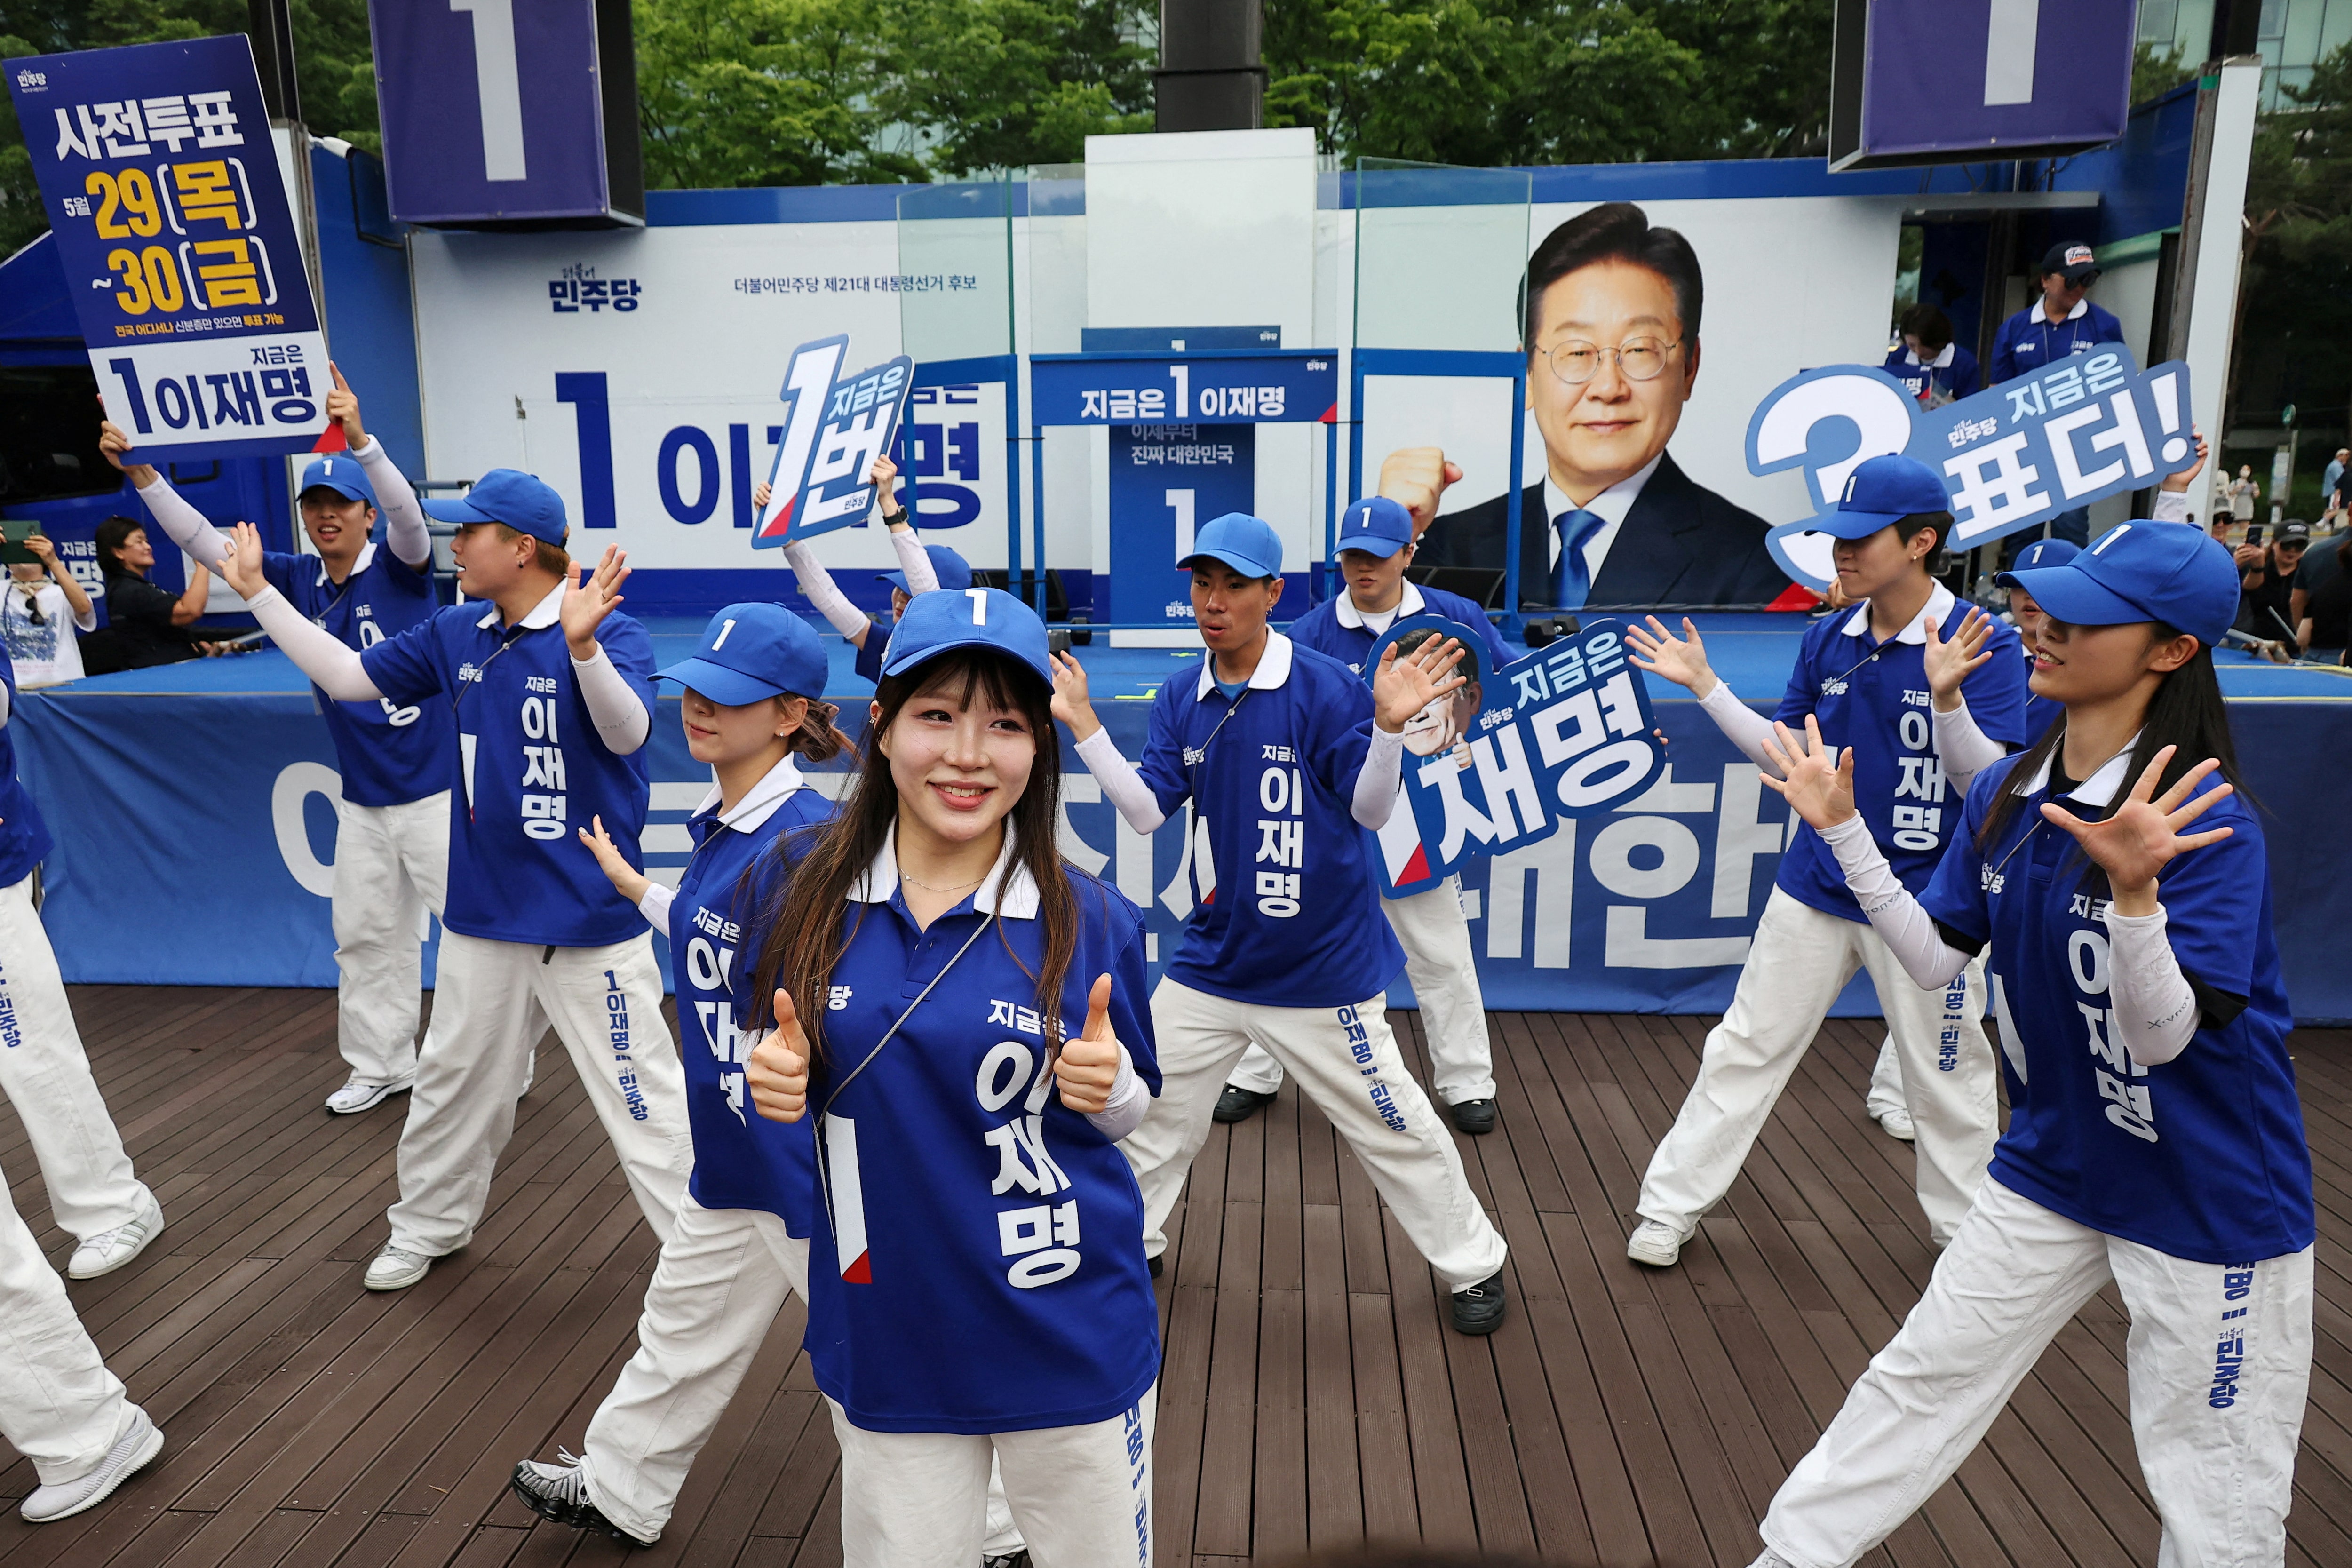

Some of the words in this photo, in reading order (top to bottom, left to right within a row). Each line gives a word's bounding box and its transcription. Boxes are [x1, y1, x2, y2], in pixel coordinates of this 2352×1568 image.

[449, 0, 527, 181] 1
[54, 90, 245, 162] 사전투표
[63, 195, 92, 218] 5월
[85, 156, 258, 240] 29(목)
[92, 235, 278, 316] ~30(금)
[548, 279, 642, 312] 민주당
[734, 275, 820, 294] 더불어민주당
[824, 275, 870, 293] 제21대
[874, 275, 944, 293] 대통령선거
[947, 274, 977, 292] 후보
[115, 324, 135, 338] 전국
[135, 321, 175, 336] 어디서나
[175, 318, 213, 333] 신분증만
[213, 316, 243, 330] 있으면
[243, 314, 264, 327] 투표
[250, 344, 304, 366] 지금은
[109, 358, 153, 434] 1
[155, 366, 317, 430] 이재명
[827, 364, 906, 422] 지금은
[1081, 388, 1166, 419] 지금은
[1169, 365, 1189, 418] 1
[1200, 386, 1286, 417] 이재명
[2005, 351, 2126, 425] 지금은
[555, 371, 617, 528] 1
[658, 422, 982, 530] 이명
[1131, 423, 1198, 441] 이제부터
[1947, 416, 1998, 449] 민주당
[2043, 371, 2189, 501] 더!
[322, 458, 334, 477] 1
[1131, 445, 1165, 465] 진짜
[1167, 444, 1235, 465] 대한민국
[1845, 475, 1859, 503] 1
[1165, 488, 1195, 571] 1
[1361, 506, 1372, 529] 1
[2032, 545, 2045, 563] 1
[2091, 523, 2133, 557] 1
[964, 589, 989, 627] 1
[711, 618, 738, 651] 1
[524, 676, 557, 694] 지금은
[1510, 630, 1623, 711] 지금은
[1479, 706, 1513, 731] 민주당
[1901, 689, 1933, 707] 지금
[520, 696, 567, 841] 이재명
[1255, 766, 1303, 918] 이재명
[692, 905, 741, 944] 지금은
[604, 970, 620, 992] 1
[607, 993, 630, 1051] 이재명
[1337, 1004, 1373, 1064] 이재명
[1939, 1030, 1959, 1071] 민주당
[618, 1073, 649, 1121] 민주당
[1369, 1084, 1406, 1132] 민주당
[2208, 1337, 2244, 1409] 민주당
